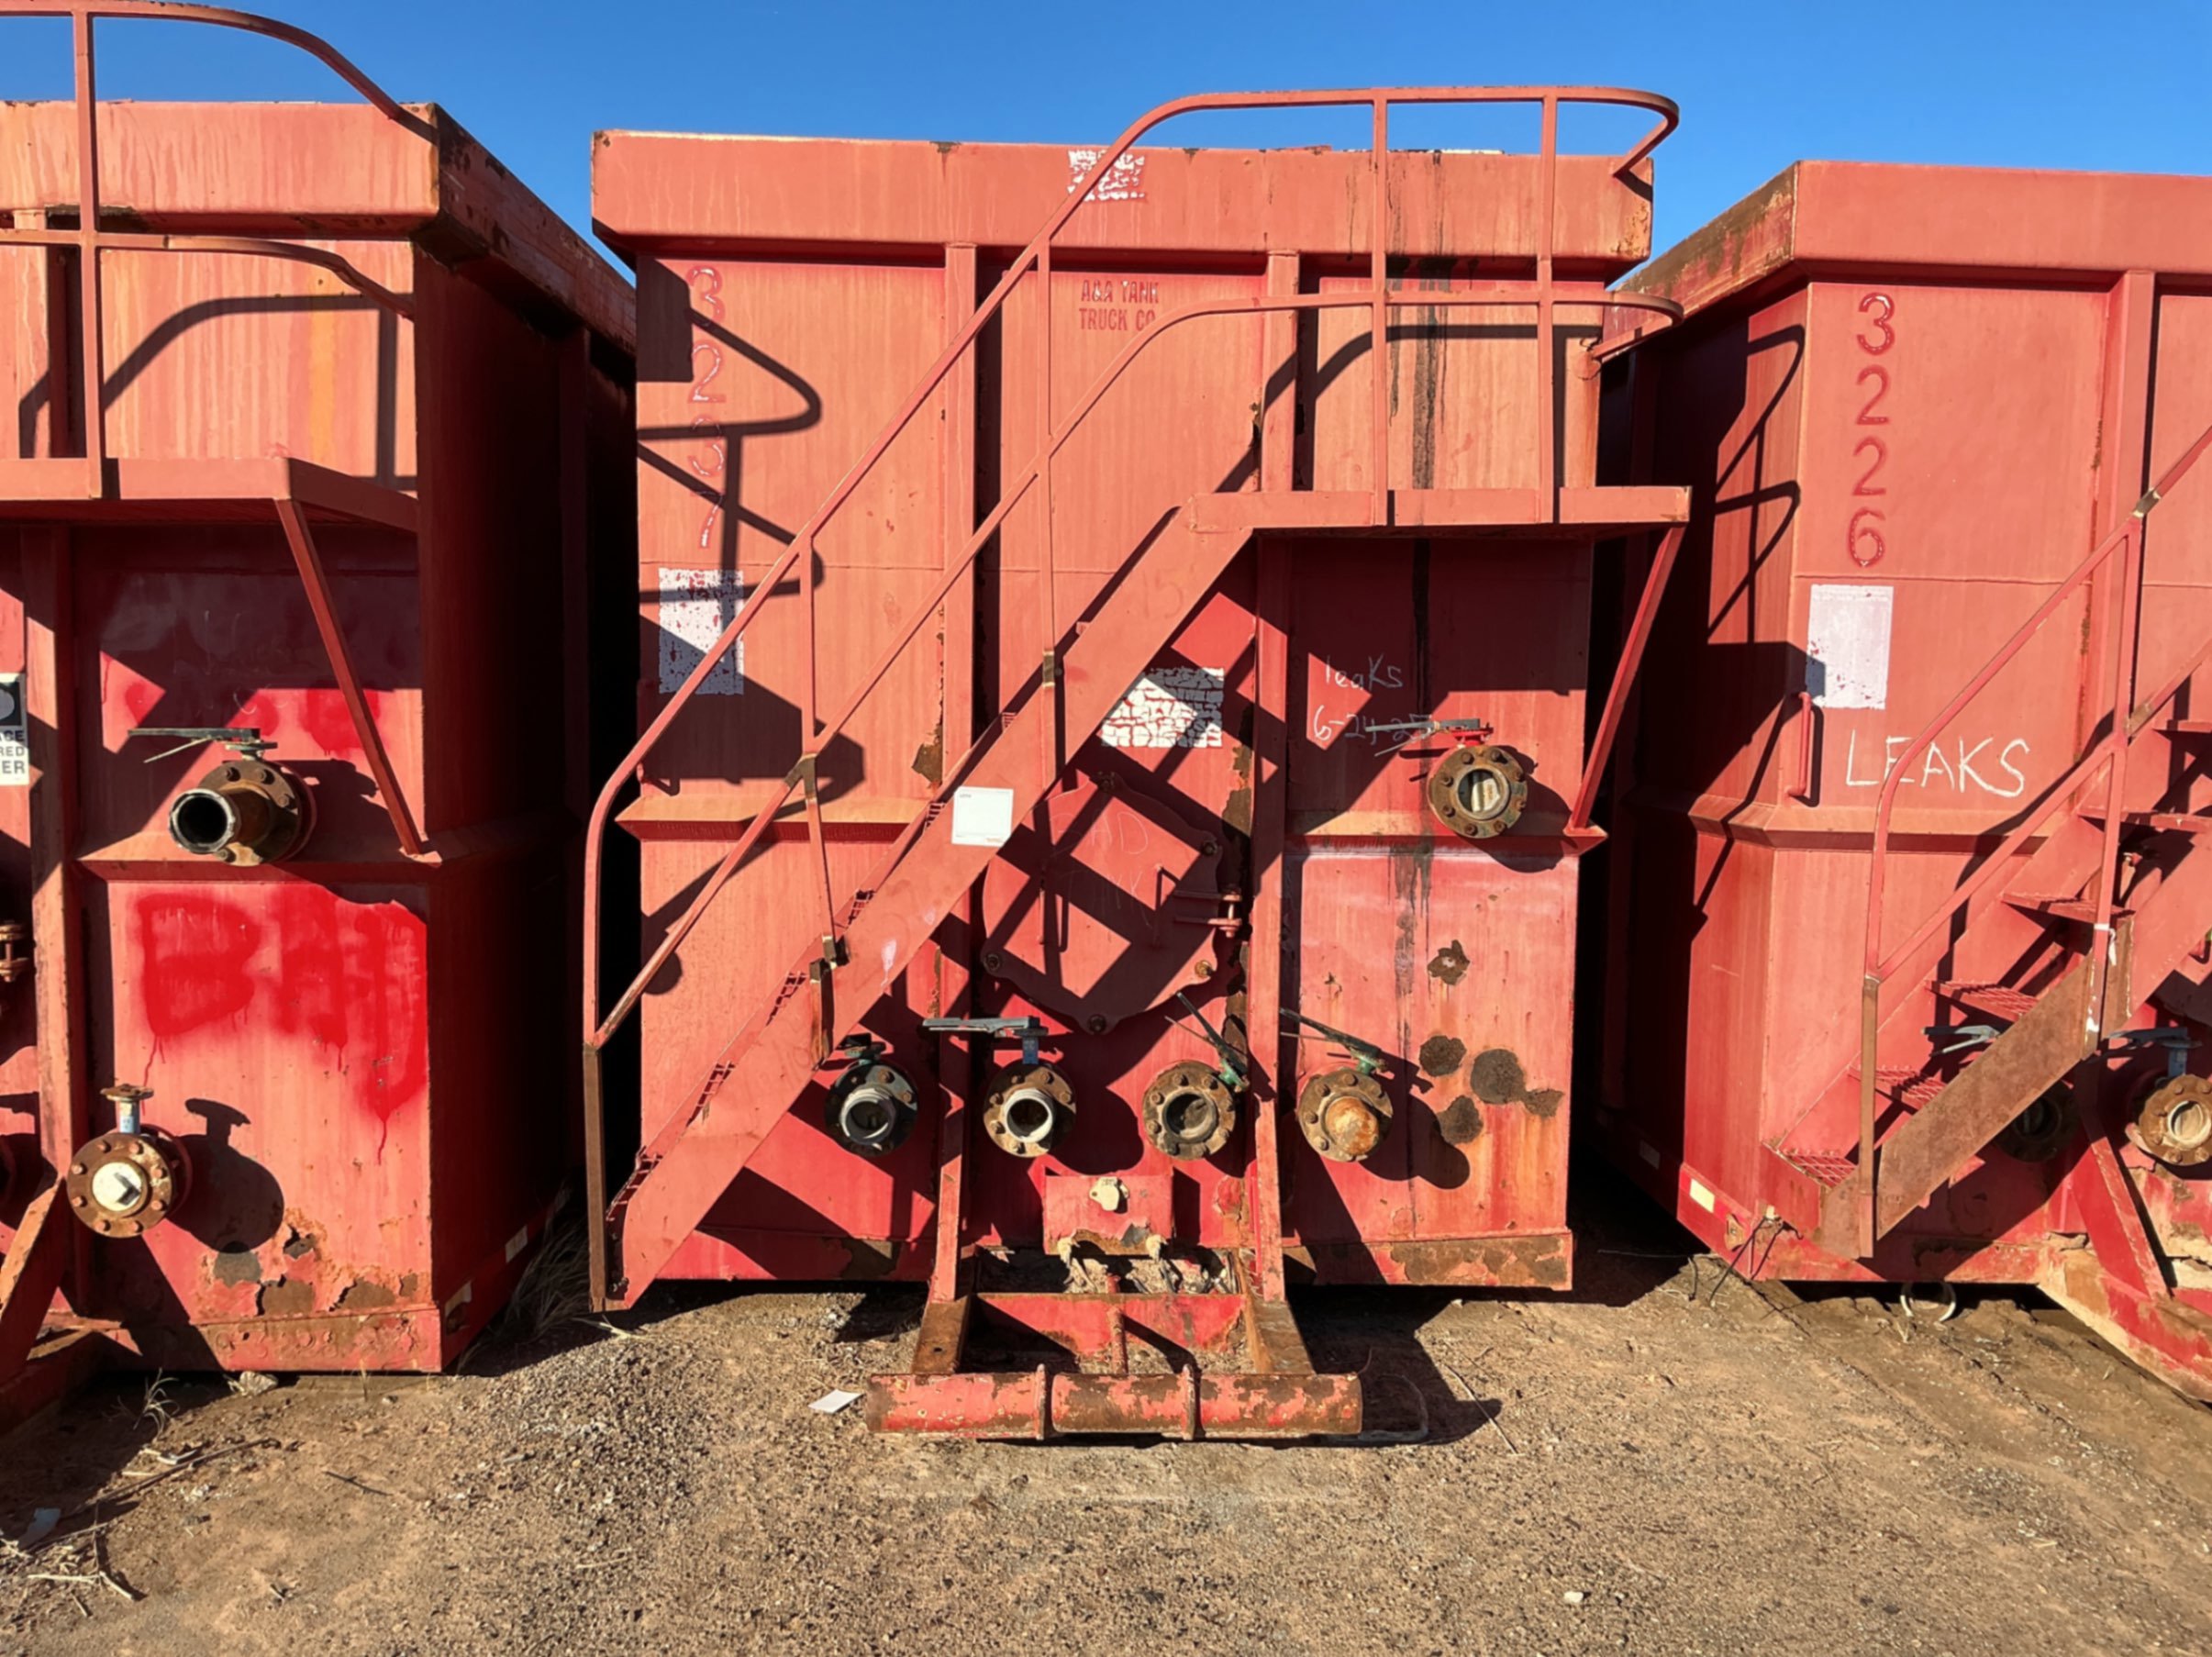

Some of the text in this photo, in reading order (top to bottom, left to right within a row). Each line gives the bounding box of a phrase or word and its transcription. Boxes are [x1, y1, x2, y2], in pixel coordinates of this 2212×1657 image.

[1081, 279, 1159, 304] A&A TANK
[1078, 307, 1128, 331] TRUCK
[1846, 292, 1896, 568] 3226
[0, 729, 25, 742] GE
[1845, 728, 2031, 798] LEAKS
